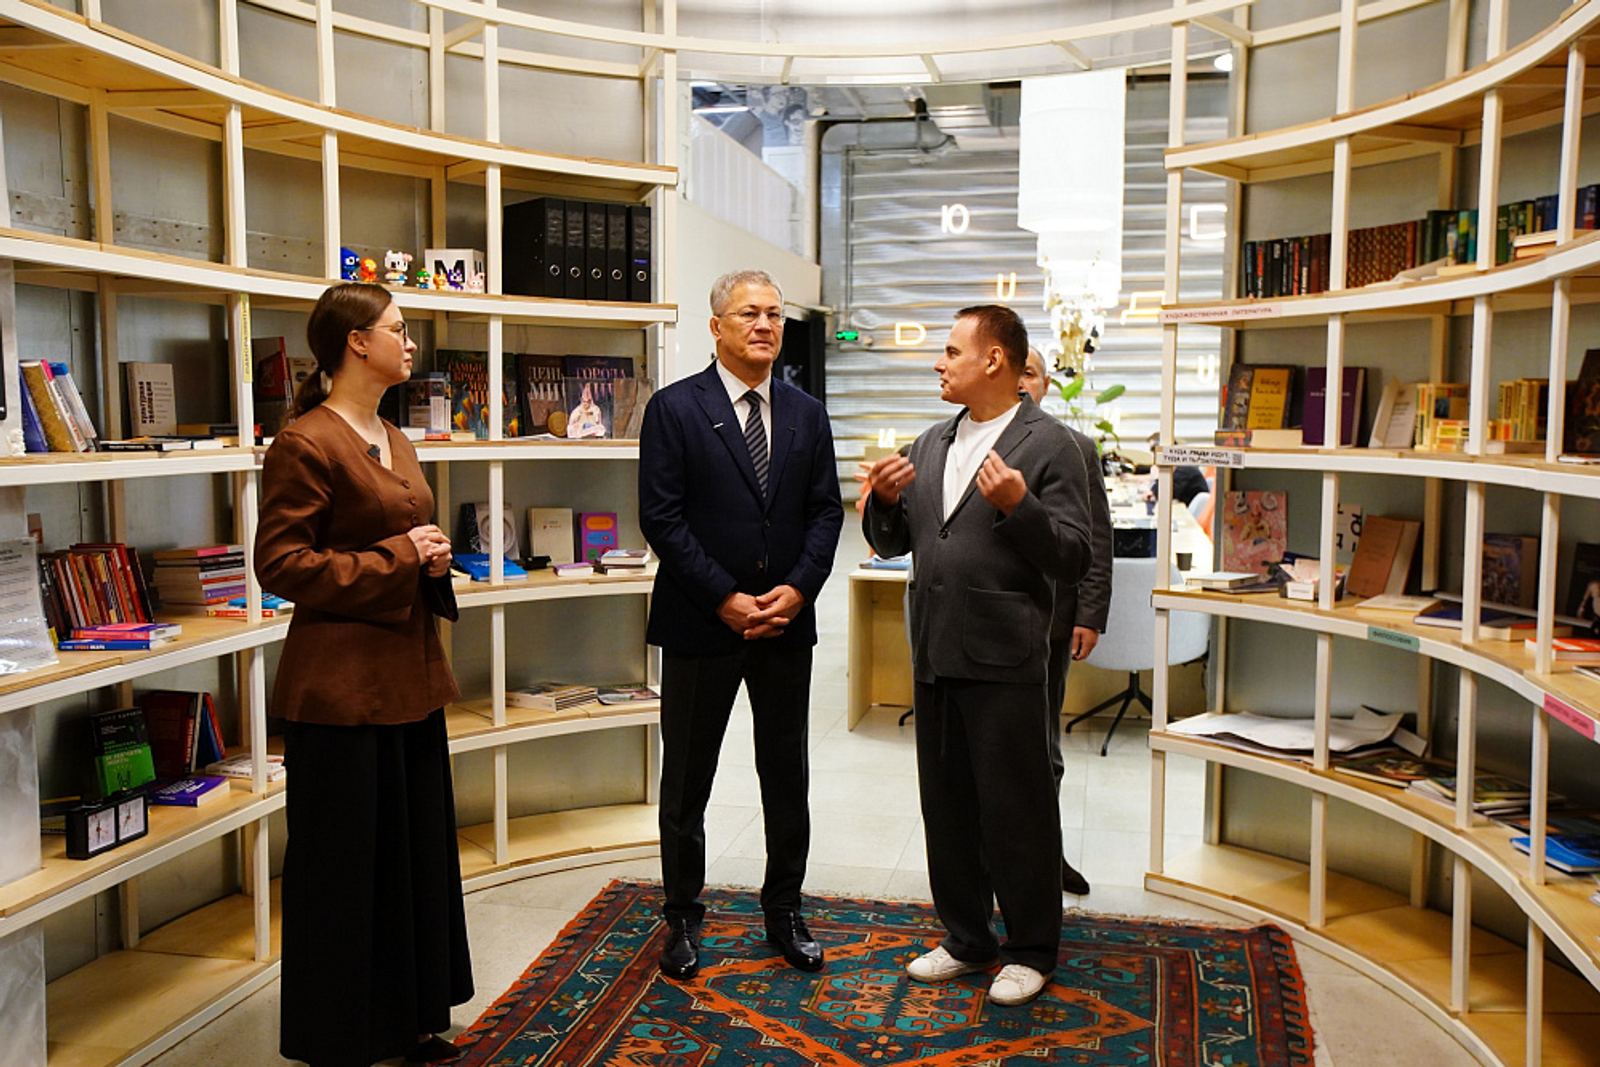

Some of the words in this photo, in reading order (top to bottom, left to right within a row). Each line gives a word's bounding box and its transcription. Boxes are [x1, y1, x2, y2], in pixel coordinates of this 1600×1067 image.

[1165, 309, 1228, 319] ХУДОЖЕСТВЕННАЯ
[1231, 307, 1272, 316] ЛИТЕРАТУРА
[1168, 448, 1187, 456] КУДА
[1163, 455, 1180, 463] ТУДА
